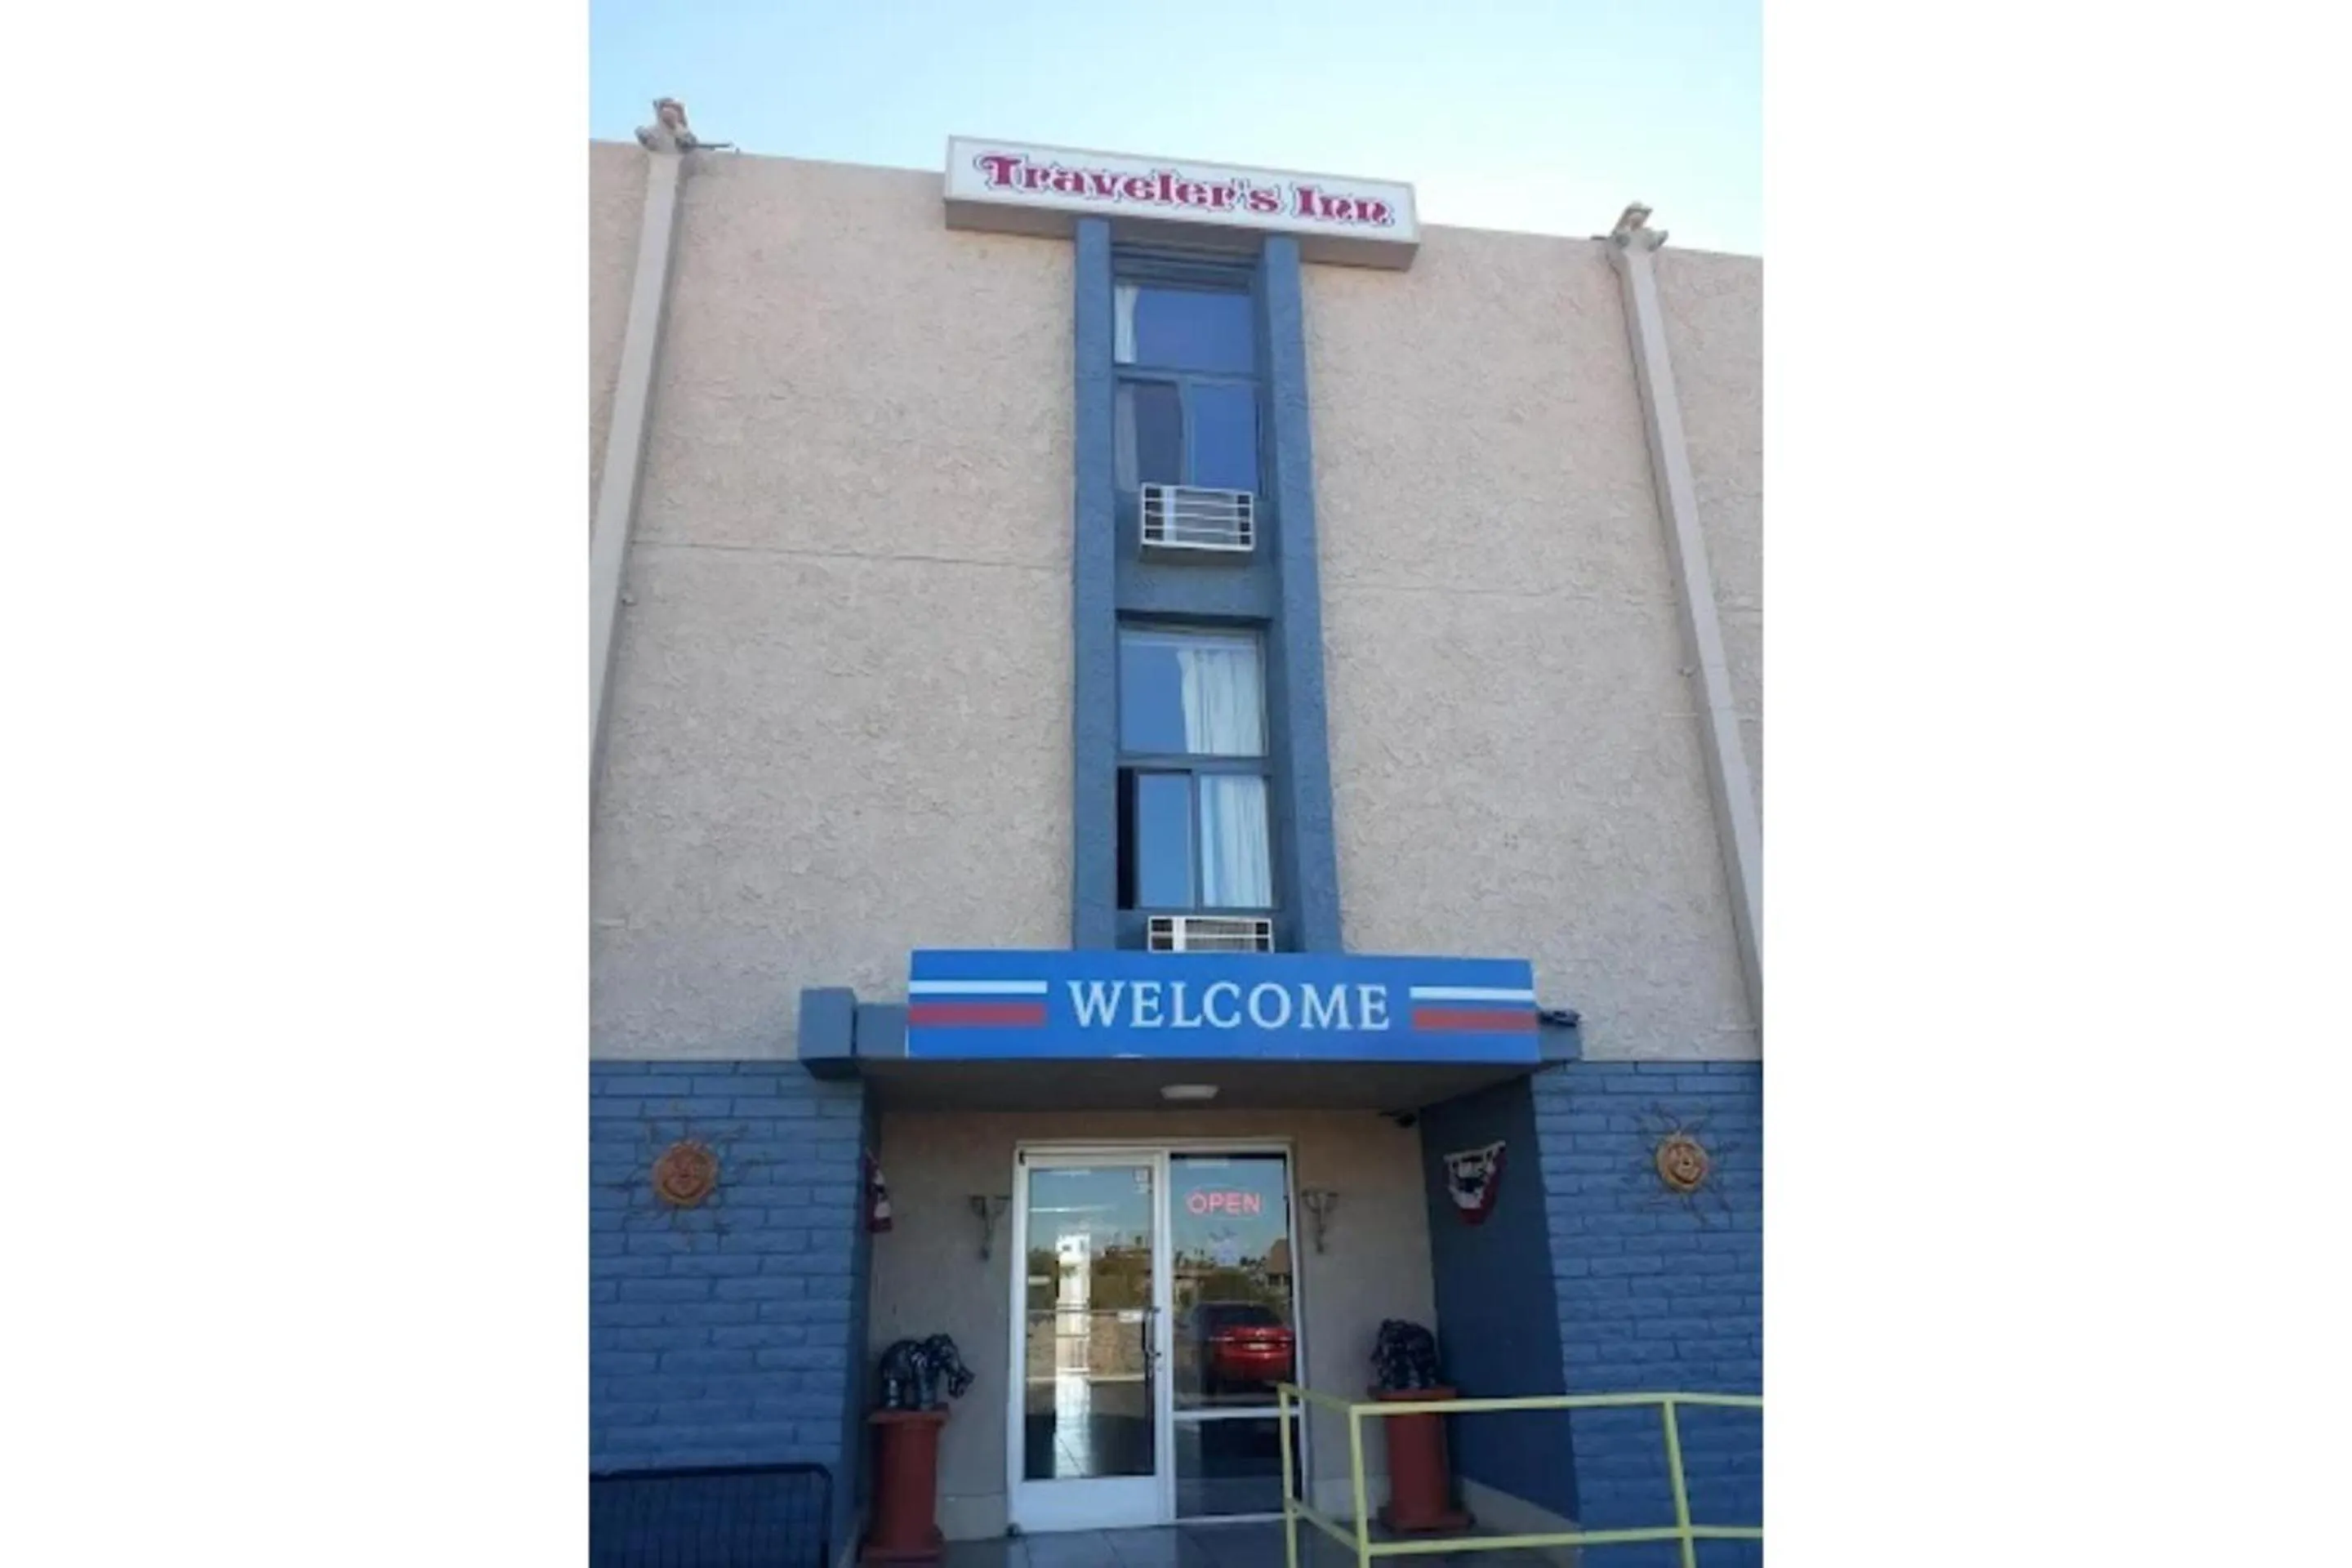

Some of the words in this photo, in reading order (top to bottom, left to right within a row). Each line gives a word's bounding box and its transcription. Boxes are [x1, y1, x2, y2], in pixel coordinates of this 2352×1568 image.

[976, 154, 1281, 214] Traveler's
[1292, 185, 1393, 225] Inn
[1067, 981, 1390, 1031] WELCOME
[1188, 1191, 1261, 1215] OPEN
